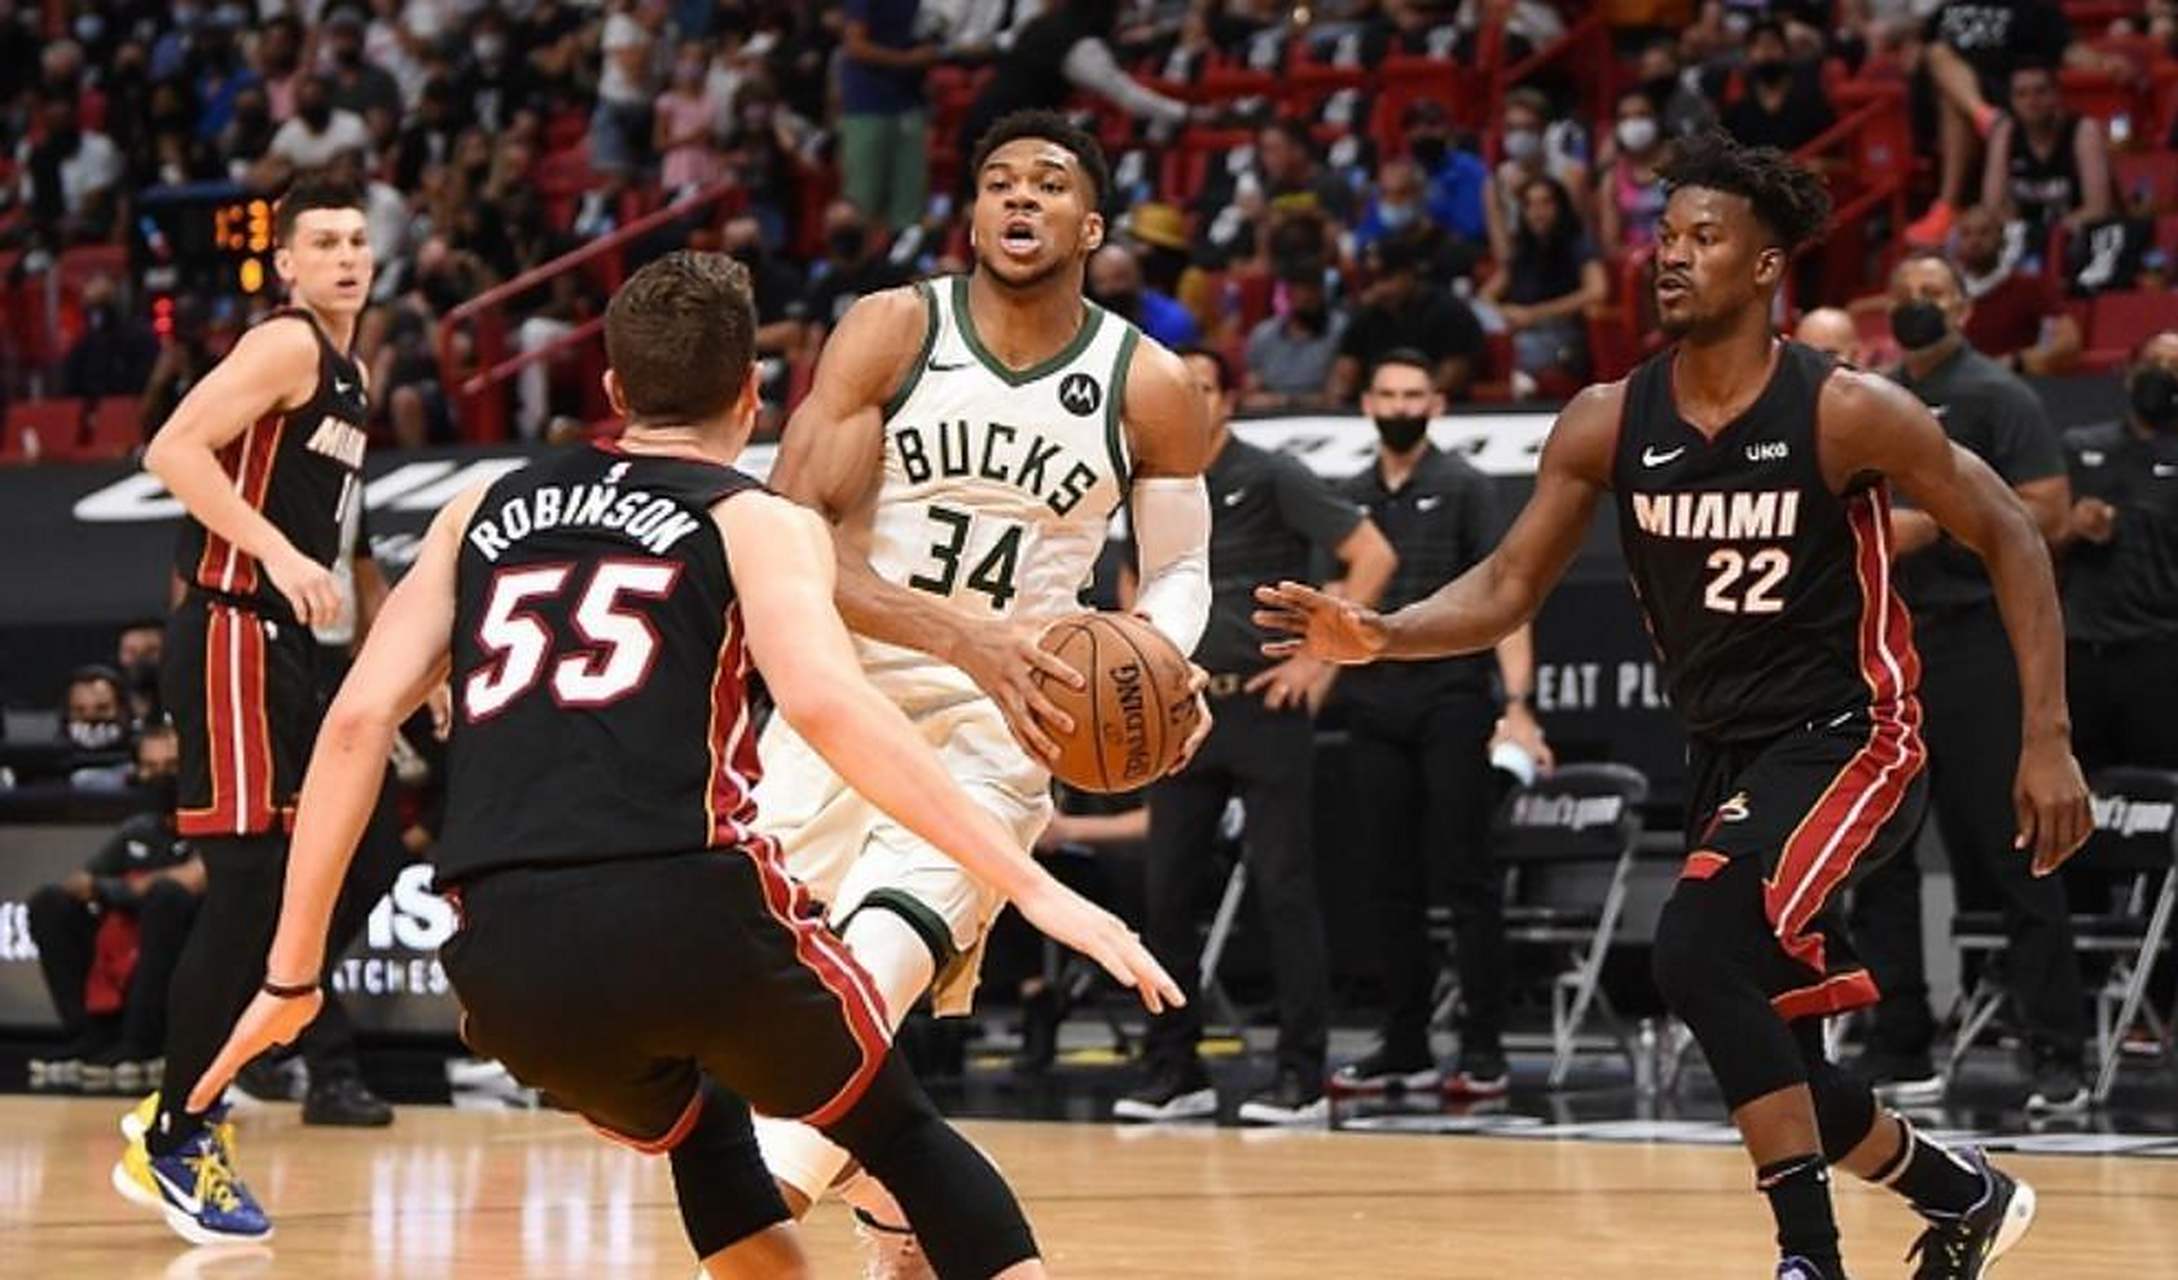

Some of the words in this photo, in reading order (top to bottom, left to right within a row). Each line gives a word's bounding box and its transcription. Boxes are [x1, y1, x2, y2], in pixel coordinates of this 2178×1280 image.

[896, 420, 1097, 517] BUCKS
[469, 484, 699, 562] ROBINSON
[1633, 491, 1799, 539] MIAMI
[909, 505, 1023, 609] 34
[1705, 548, 1791, 614] 22
[464, 557, 684, 723] 55
[1110, 662, 1150, 781] SPALDING
[1537, 663, 1599, 710] EAT
[333, 957, 449, 994] TCHES
